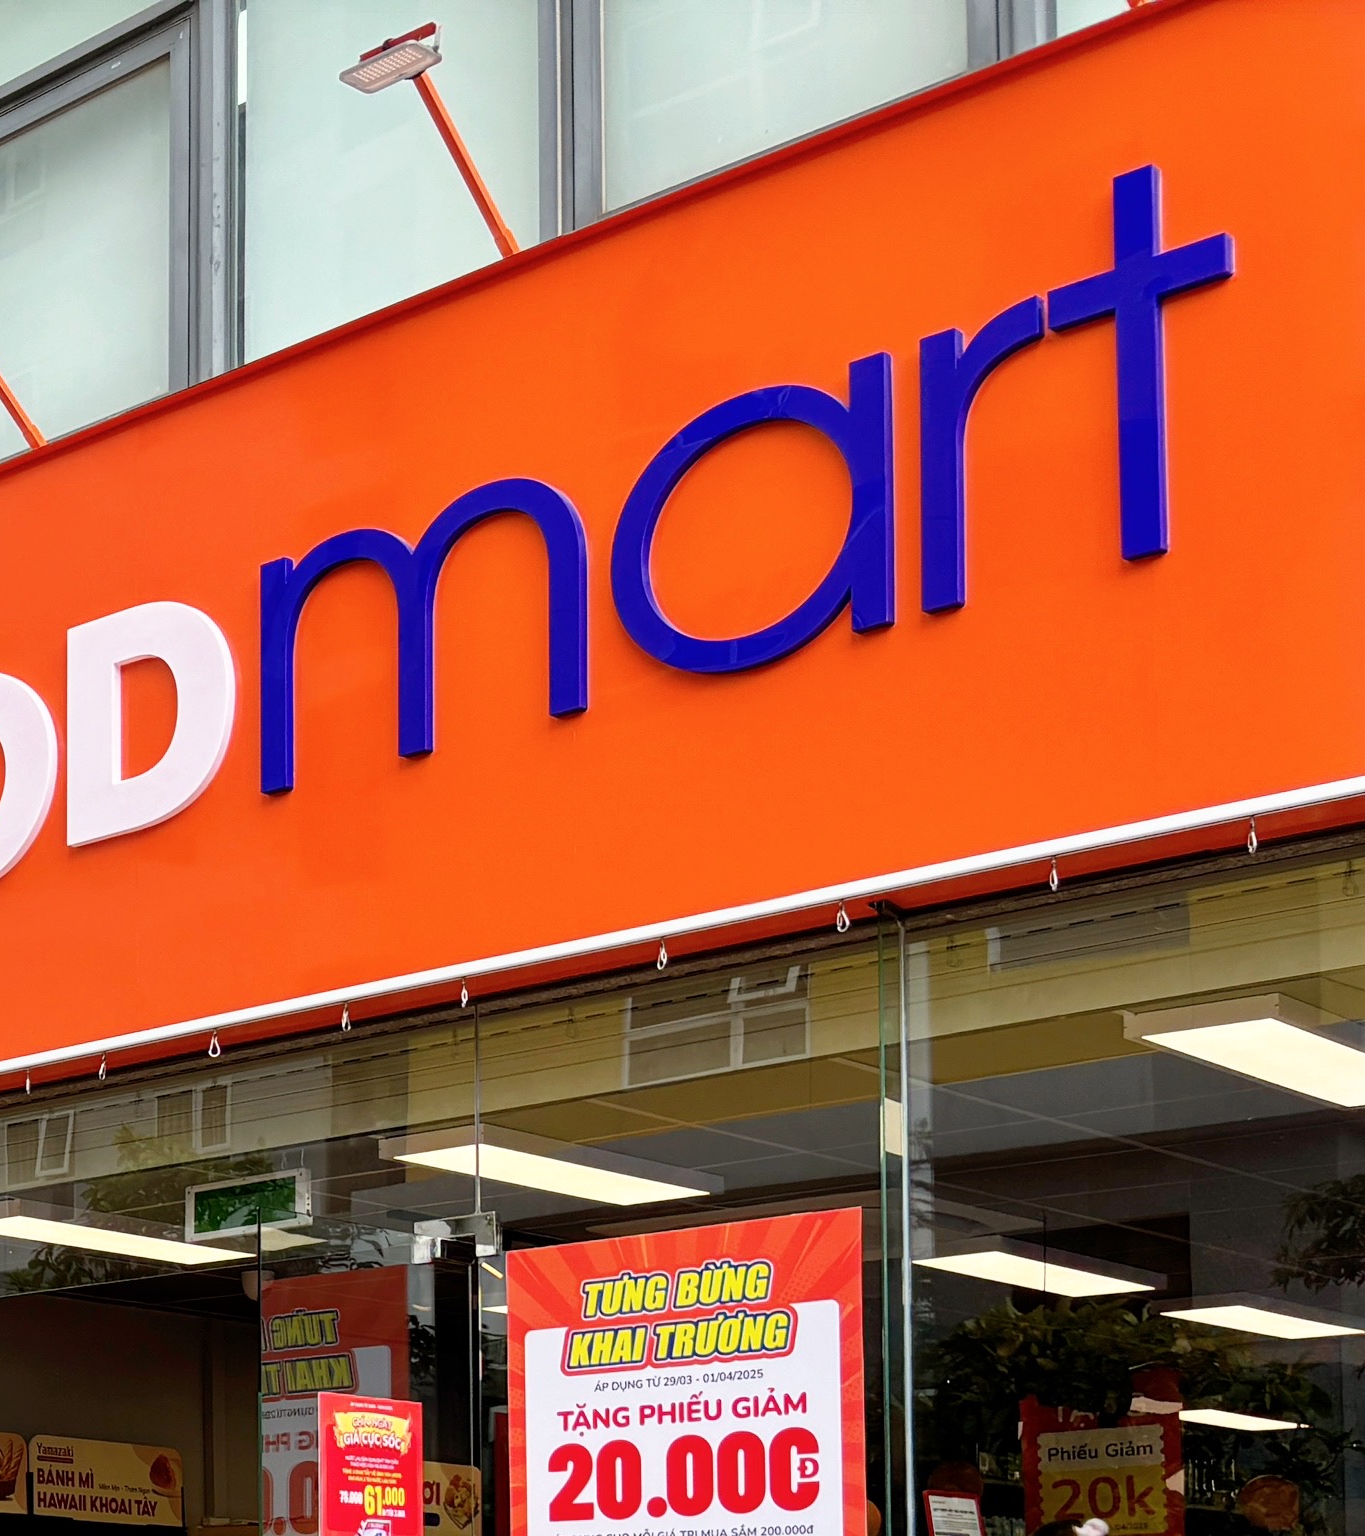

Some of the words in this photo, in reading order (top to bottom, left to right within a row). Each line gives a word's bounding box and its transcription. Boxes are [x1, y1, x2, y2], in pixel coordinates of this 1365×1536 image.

[583, 1272, 668, 1318] TƯNG
[673, 1260, 771, 1308] BỪNG
[567, 1325, 647, 1368] KHAI
[654, 1309, 790, 1361] TRƯƠNG
[594, 1380, 609, 1392] ÁP
[612, 1379, 643, 1392] DỤNG
[645, 1376, 661, 1388] TỪ
[664, 1375, 692, 1388] 29/03
[703, 1369, 764, 1384] 01/04/2025
[557, 1403, 630, 1436] TẶNG
[639, 1391, 721, 1426] PHIẾU
[731, 1388, 807, 1418] GIẢM
[37, 1442, 74, 1457] Yamazaki
[343, 1430, 359, 1446] GIÁ
[382, 1431, 401, 1450] SỐC
[1047, 1443, 1098, 1462] Phiếu
[1105, 1440, 1153, 1458] Giảm
[37, 1465, 75, 1487] BÁNH
[79, 1469, 94, 1489] MÌ
[37, 1491, 86, 1511] HAWAII
[90, 1495, 132, 1515] KHOAI
[134, 1497, 157, 1517] TÂY
[364, 1484, 405, 1515] 61.000
[1052, 1474, 1156, 1520] 20k
[731, 1524, 757, 1536] SẮM
[760, 1524, 814, 1536] 200.000đ
